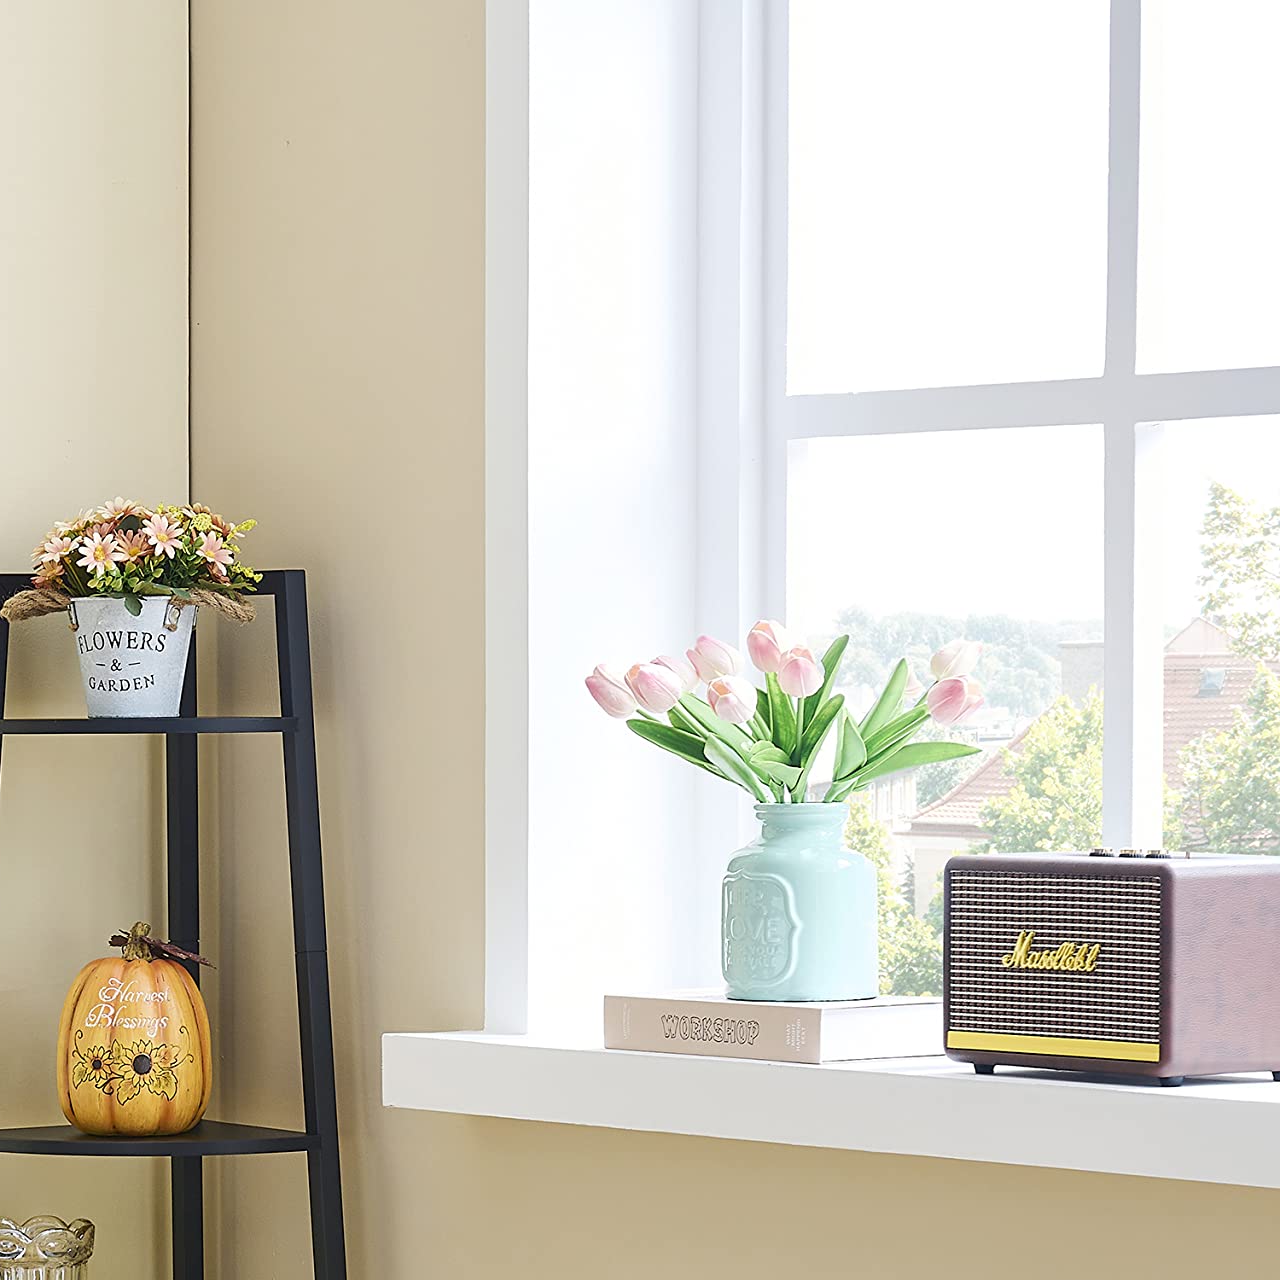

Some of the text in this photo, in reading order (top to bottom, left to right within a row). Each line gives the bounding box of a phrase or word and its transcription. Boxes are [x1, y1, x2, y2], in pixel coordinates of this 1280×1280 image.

[78, 630, 167, 655] FLOWERS
[110, 658, 122, 672] &
[88, 674, 156, 692] GARDEN
[98, 977, 170, 1003] Harvest
[85, 1003, 169, 1038] Blessings
[660, 1014, 760, 1046] WORKSHOP
